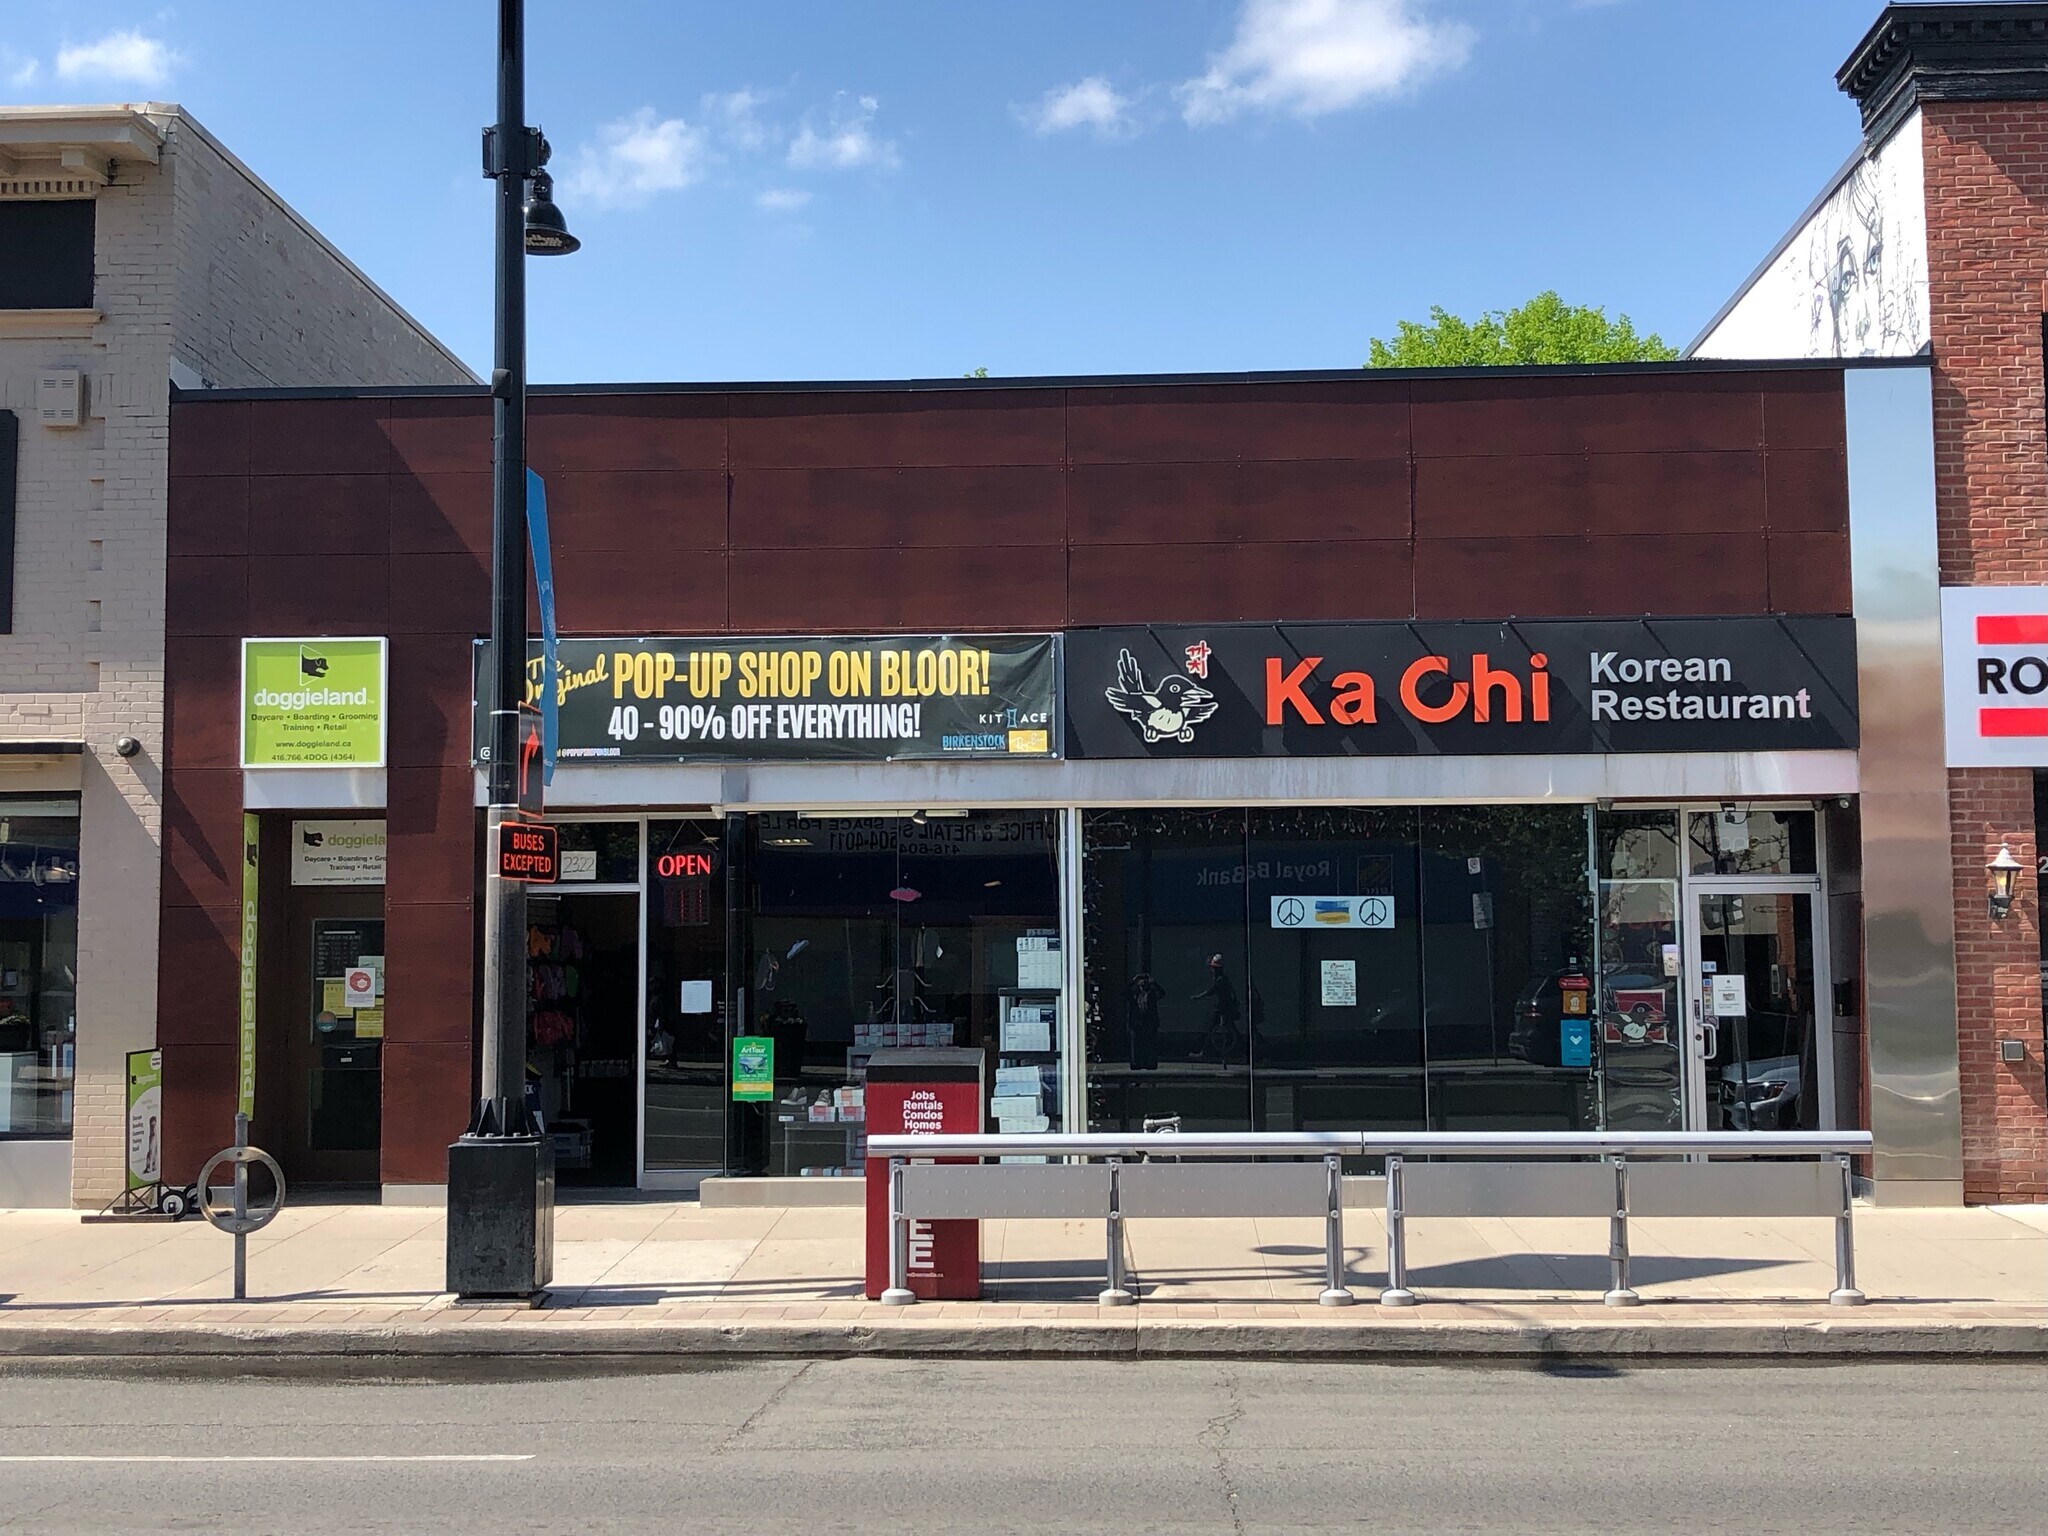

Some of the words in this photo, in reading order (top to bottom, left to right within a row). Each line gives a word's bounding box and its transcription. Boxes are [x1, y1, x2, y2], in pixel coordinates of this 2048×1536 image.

[1185, 640, 1211, 679] 까치
[1589, 651, 1731, 684] Korean
[613, 650, 732, 699] POP-UP
[738, 650, 823, 698] SHOP
[828, 650, 872, 698] ON
[878, 648, 991, 698] BLOOR!
[1977, 656, 2048, 695] RO
[253, 687, 367, 710] doggieland
[1265, 656, 1378, 725] Ka
[1400, 652, 1550, 724] Chi
[1590, 687, 1812, 722] Restaurant
[251, 713, 284, 722] Daycare
[293, 713, 330, 722] Boarding
[338, 712, 379, 721] Grooming
[607, 704, 639, 741] 40
[659, 703, 726, 741] 90%
[731, 702, 772, 740] OFF
[777, 701, 922, 740] EVERYTHING!
[979, 713, 1003, 724] KIT
[1020, 712, 1048, 723] ACE
[282, 723, 315, 732] Training
[323, 723, 348, 731] Retail
[275, 740, 352, 749] www.doggieland.ca
[942, 734, 1006, 748] BIRKENSTOCK
[512, 832, 545, 851] BUSES
[503, 852, 551, 873] EXCEPTED
[562, 855, 595, 874] 2322
[657, 854, 711, 877] OPEN
[241, 900, 258, 1098] doggieland
[903, 1100, 944, 1110] Rentals
[910, 1090, 936, 1101] Jobs
[902, 1110, 944, 1120] Condos
[904, 1120, 942, 1130] Homes
